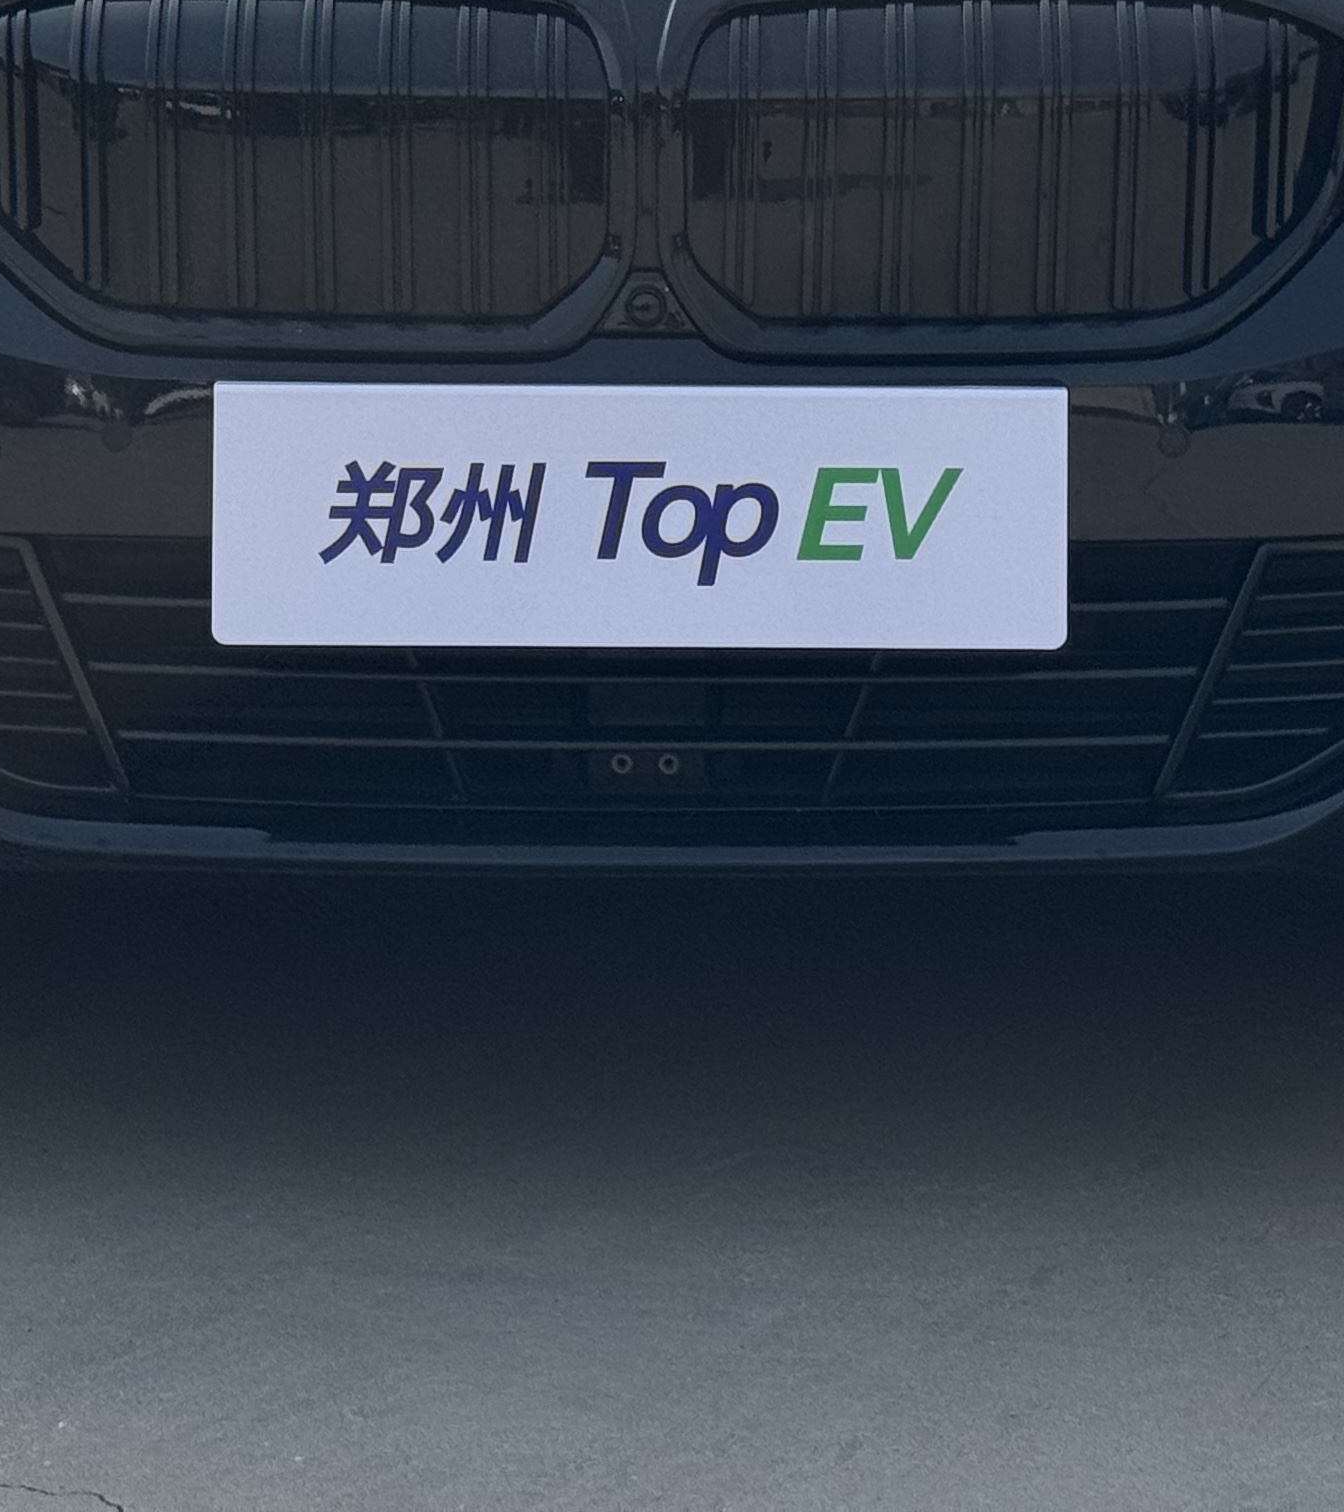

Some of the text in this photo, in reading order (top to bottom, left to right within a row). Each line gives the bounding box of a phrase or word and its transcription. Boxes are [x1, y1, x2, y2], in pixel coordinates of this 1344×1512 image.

[318, 459, 964, 587] 郑州 Top EV
